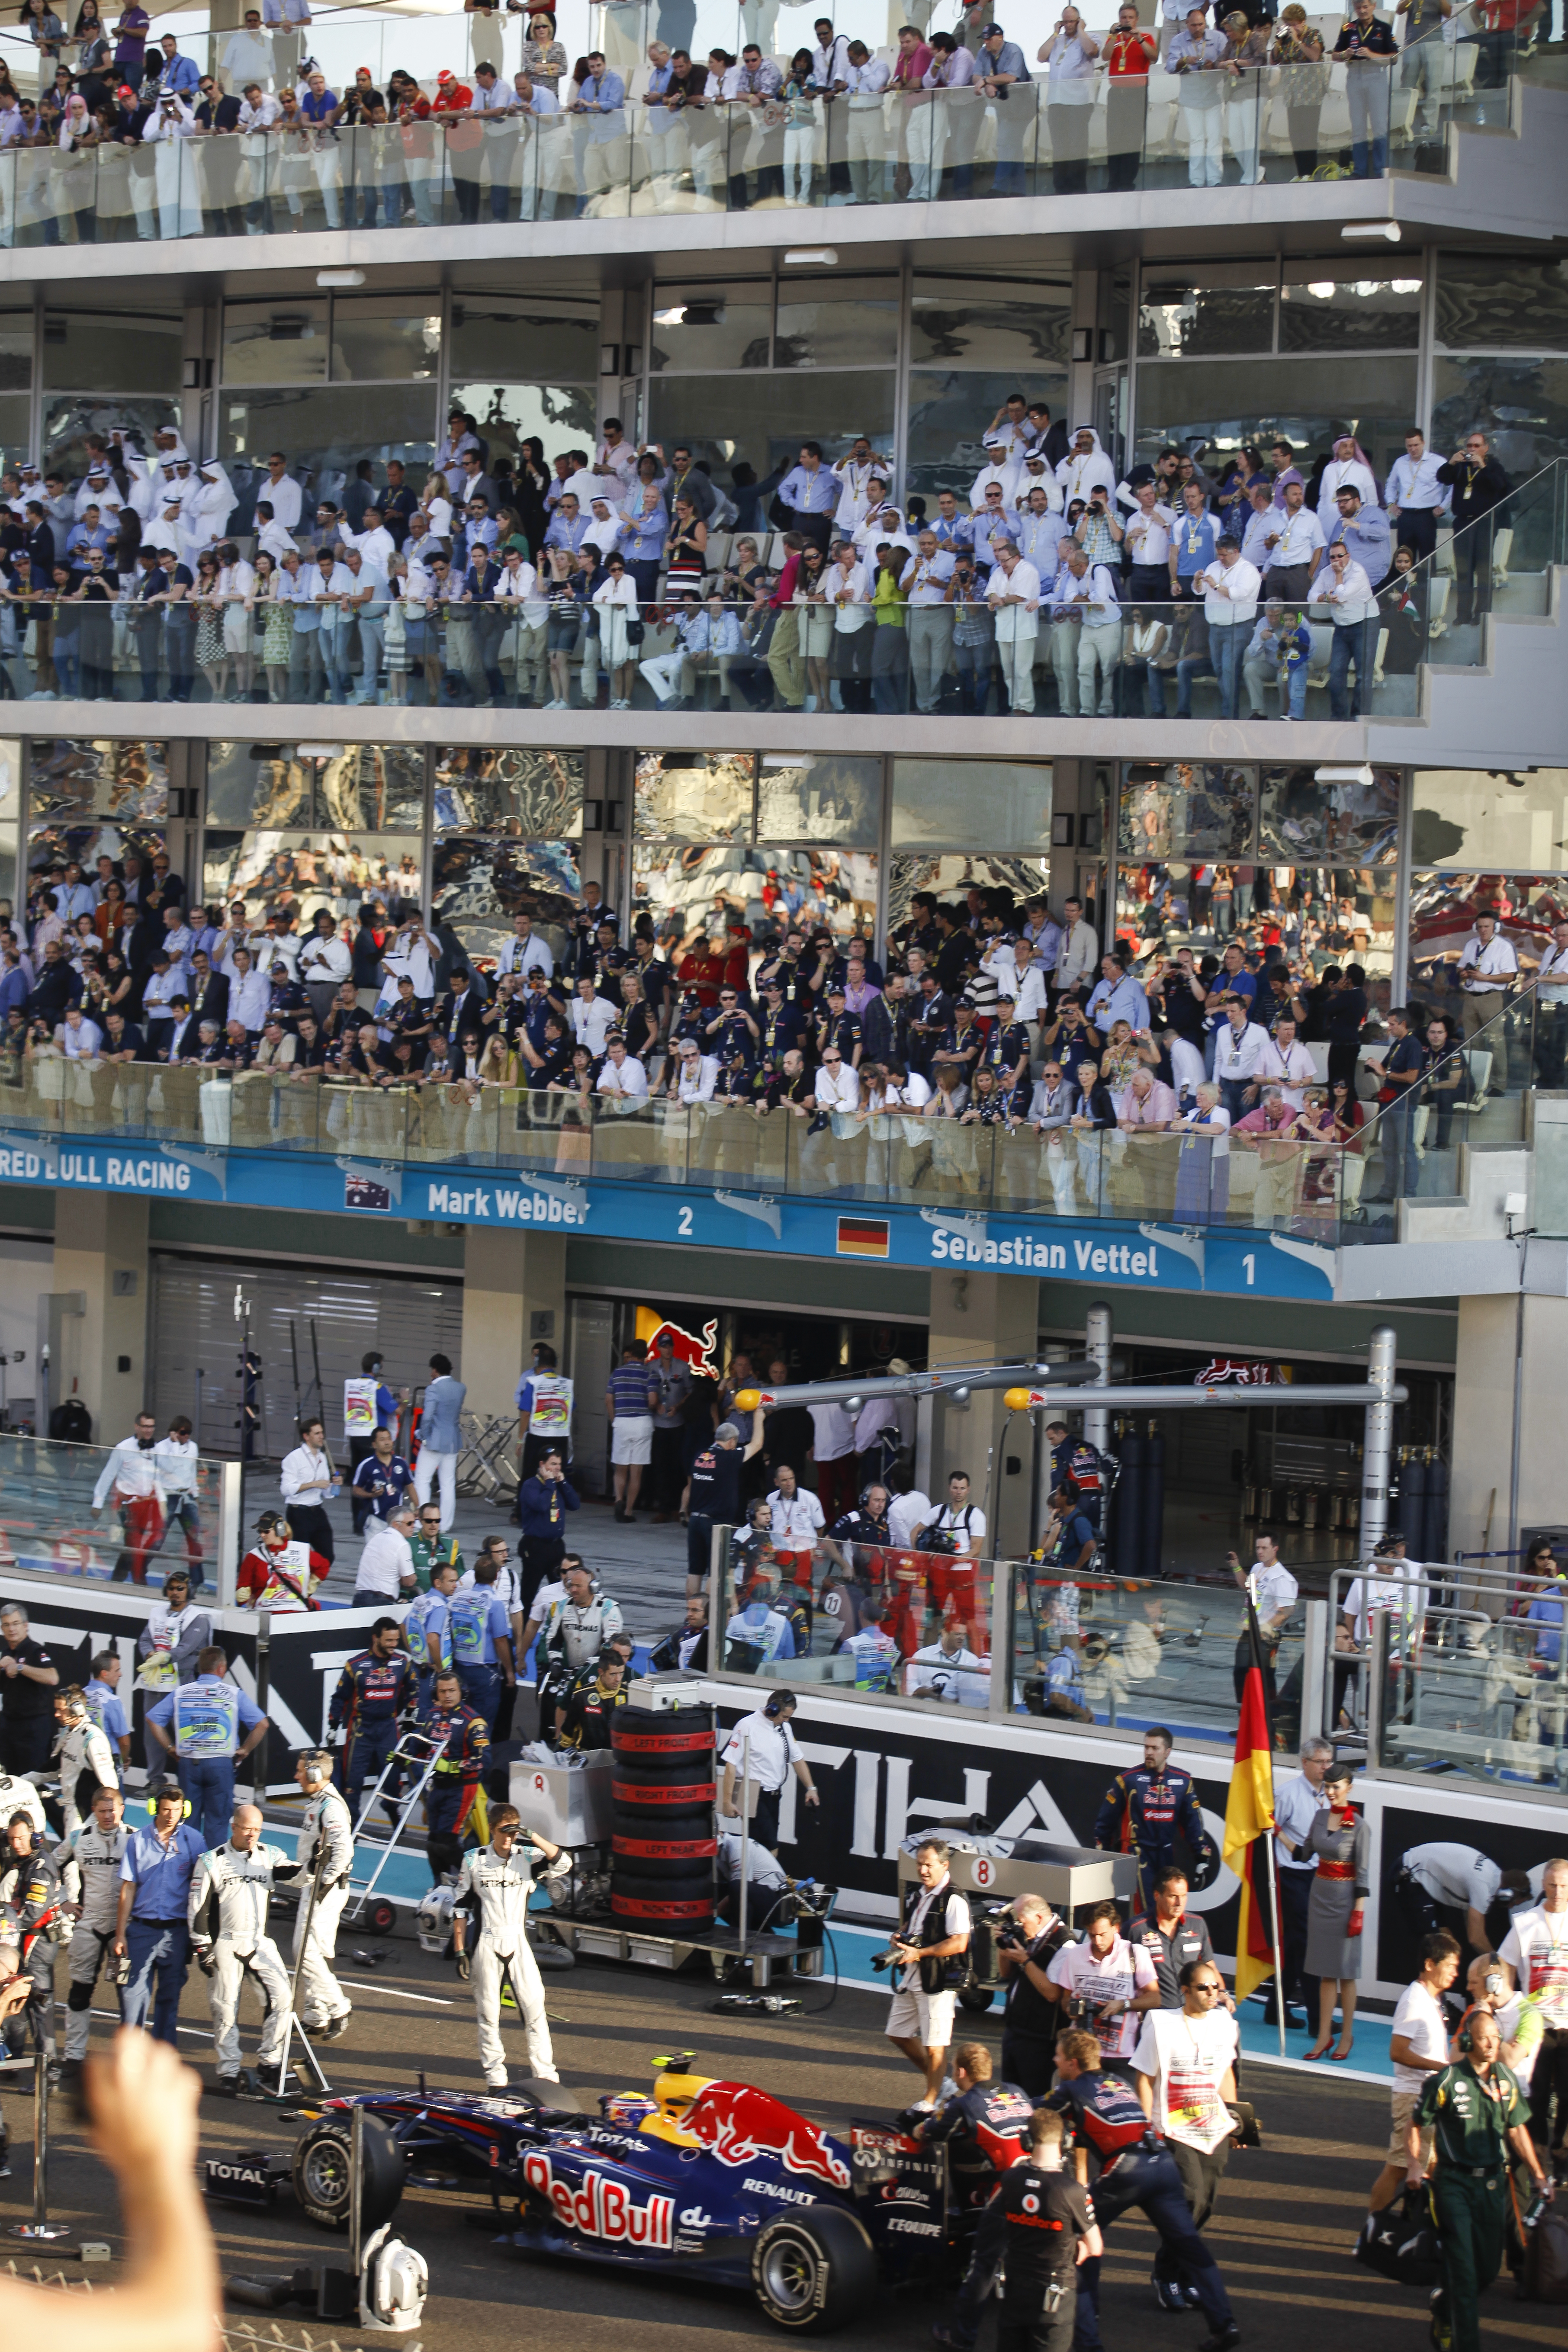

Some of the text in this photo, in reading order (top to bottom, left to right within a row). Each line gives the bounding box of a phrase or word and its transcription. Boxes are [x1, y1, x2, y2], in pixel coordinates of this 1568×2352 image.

[0, 1149, 40, 1179] RED
[106, 1157, 191, 1191] RACING
[428, 1184, 490, 1217] Mark
[677, 1206, 693, 1235] 2
[930, 1228, 1159, 1278] Sebastian Vettel
[1242, 1253, 1255, 1285] 1
[120, 1272, 131, 1291] 7
[538, 1313, 548, 1332] 6
[634, 1738, 655, 1748] LEFT
[658, 1738, 691, 1748] FRONT
[635, 1790, 663, 1799] RIGHT
[666, 1789, 698, 1799] FRONT
[646, 1845, 695, 1854] LEFT REAR
[222, 1874, 268, 1885] PETRONAS
[978, 1860, 988, 1884] 8
[589, 2126, 651, 2152] TOTAL
[852, 2128, 907, 2151] TOTAL
[489, 2146, 500, 2167] 2
[880, 2156, 944, 2175] INFINITI
[206, 2159, 266, 2185] TOTAL
[524, 2152, 676, 2249] Red Bull
[741, 2178, 818, 2206] RENAULT
[1006, 2211, 1064, 2232] vodafone
